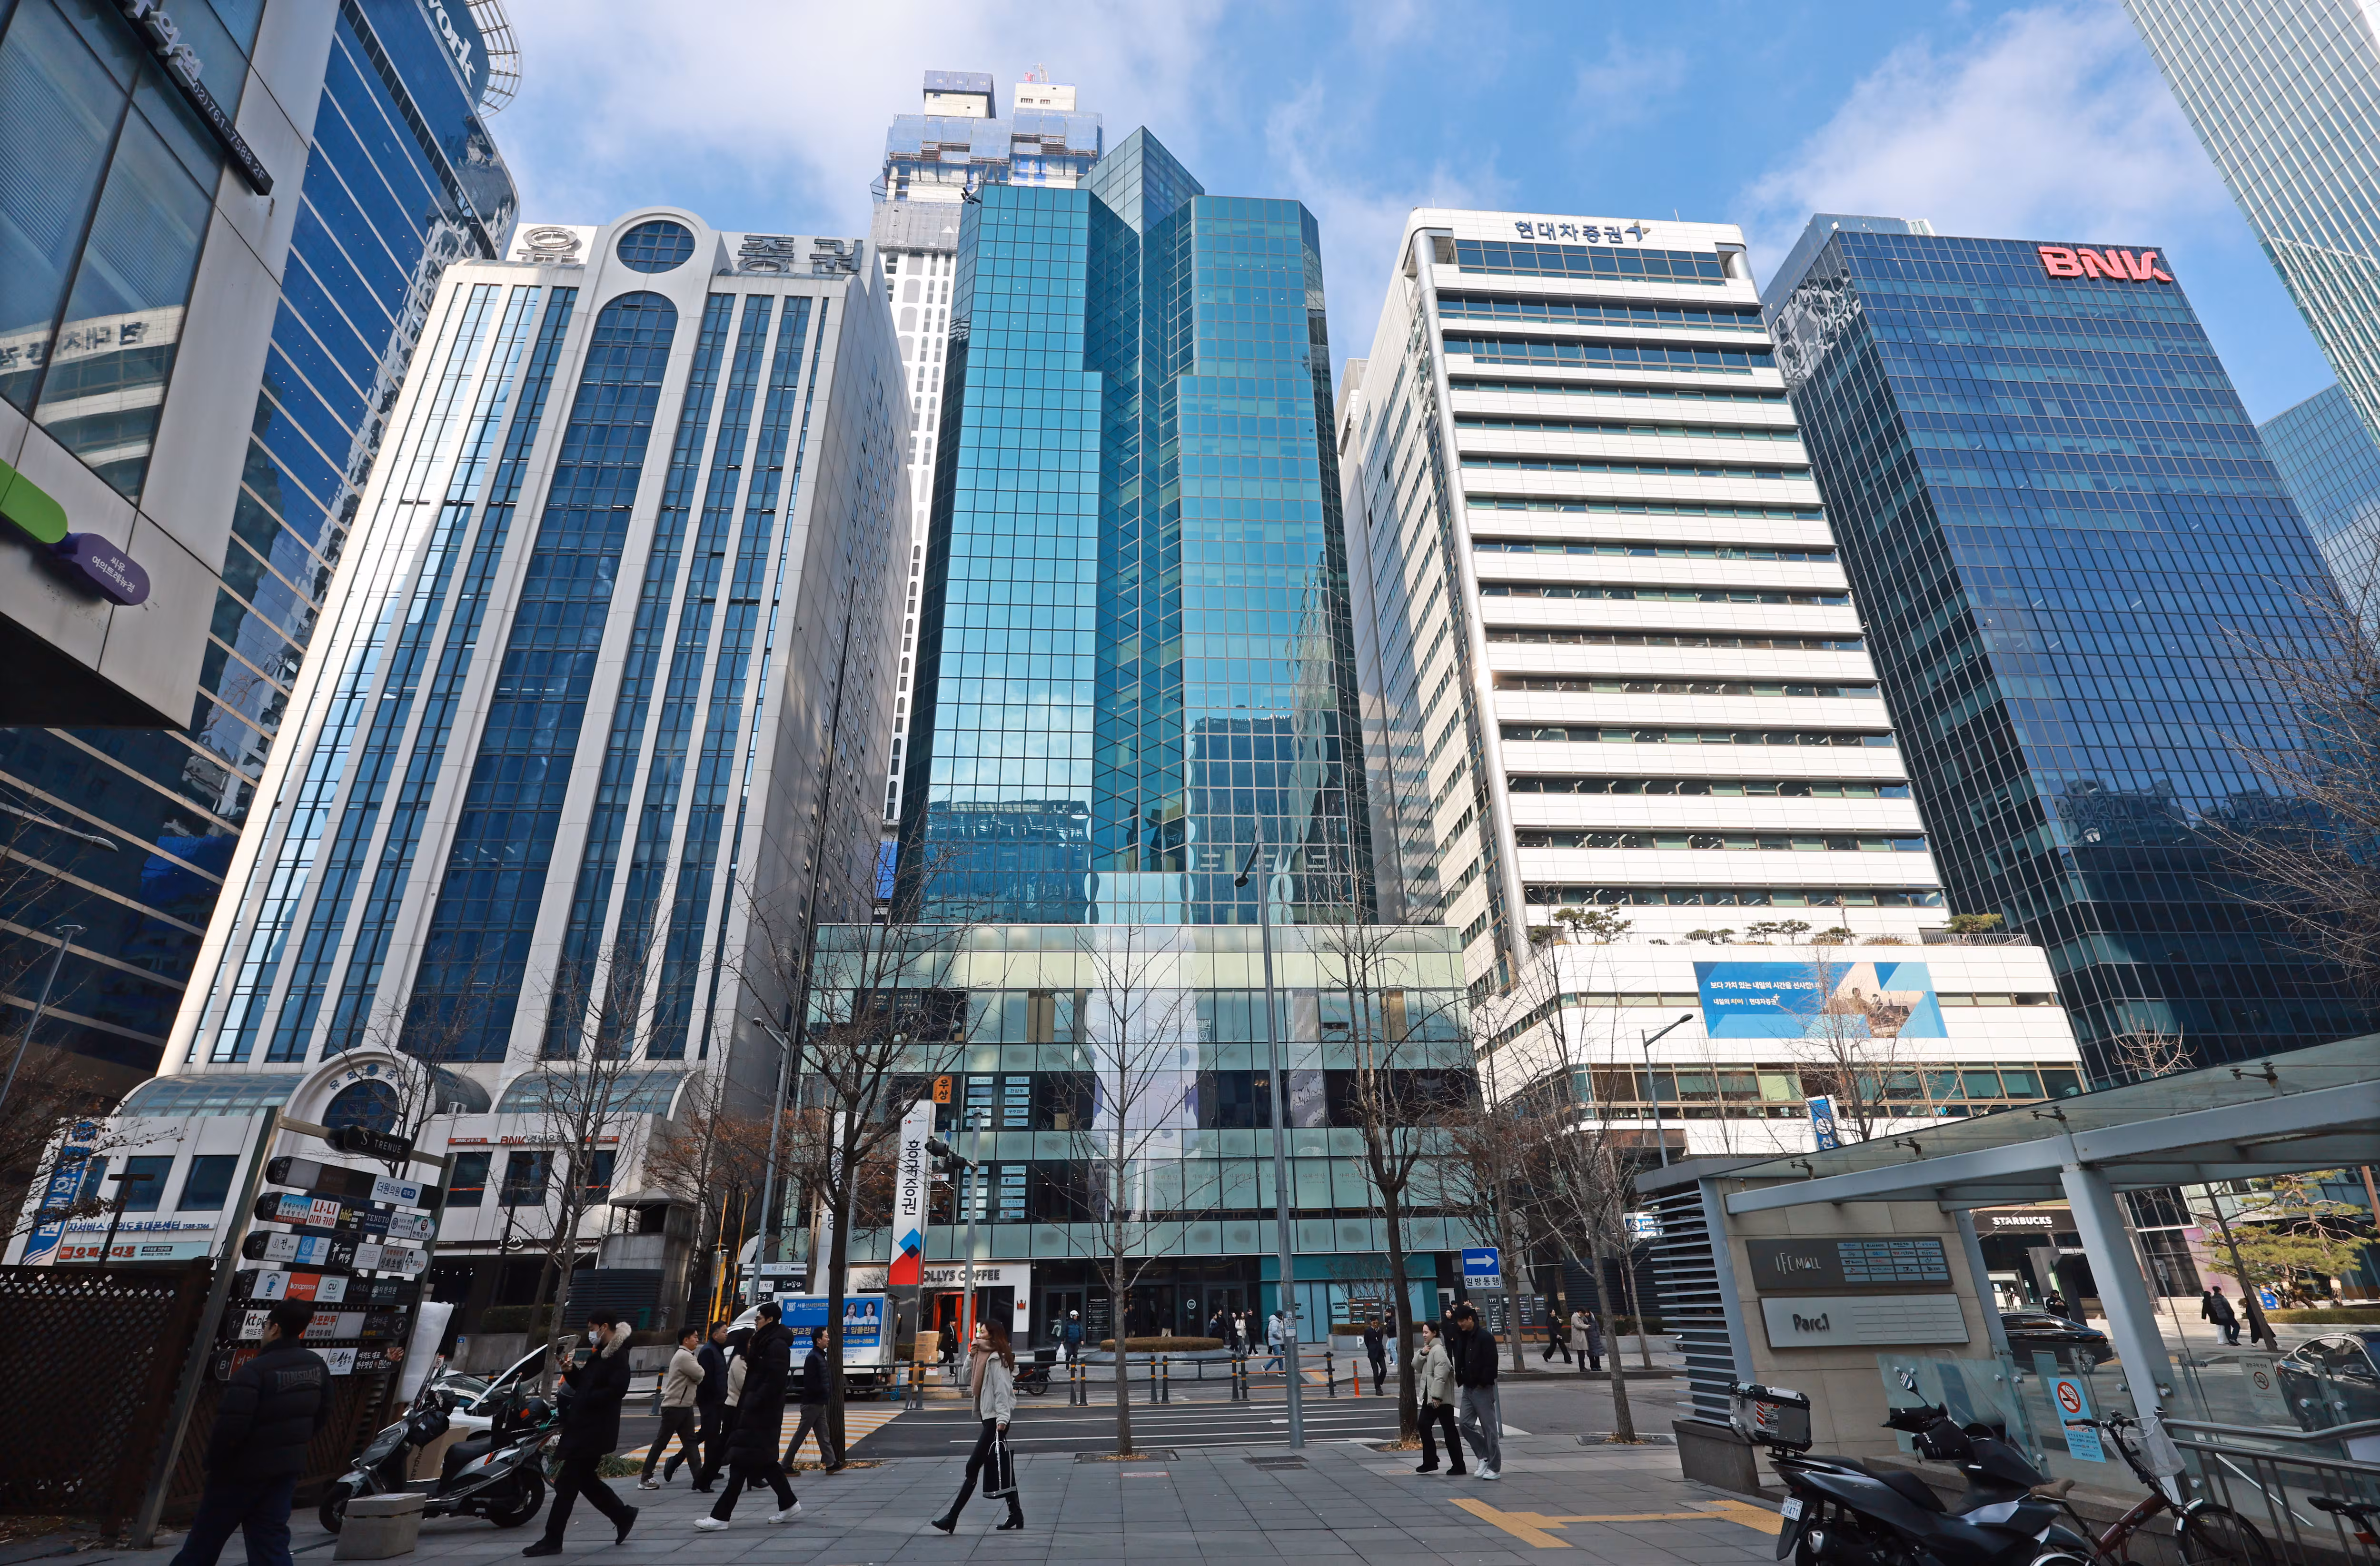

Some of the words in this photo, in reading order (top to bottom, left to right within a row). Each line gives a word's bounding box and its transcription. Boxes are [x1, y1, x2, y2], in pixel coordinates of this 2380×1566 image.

[192, 82, 252, 165] 02)761-7588
[253, 162, 266, 180] 2F
[1515, 220, 1624, 244] 현대차증권
[2038, 246, 2173, 283] BNK
[110, 556, 126, 572] 씨유
[92, 555, 136, 594] 여의트레뉴점
[500, 1136, 526, 1144] BNK
[374, 1139, 402, 1154] TRENUE
[276, 1171, 285, 1179] 3F
[901, 1140, 922, 1215] 흥국증권
[377, 1182, 401, 1197] 더원의원
[267, 1201, 277, 1210] 3F
[339, 1208, 352, 1222] bhc
[366, 1214, 389, 1224] TENUTO
[1992, 1216, 2053, 1226] STARBUCKS
[412, 1230, 431, 1239] 한마음약국
[255, 1240, 266, 1249] 2F
[1775, 1252, 1794, 1275] IFC
[245, 1273, 255, 1283] 2F
[923, 1269, 956, 1282] OLLYS
[290, 1282, 316, 1290] banapresso
[1466, 1277, 1500, 1286] 일방통행
[245, 1313, 257, 1327] kt
[1792, 1312, 1830, 1331] Parc.1
[851, 1326, 876, 1334] 임플란트
[358, 1352, 371, 1360] 여의도
[356, 1360, 374, 1369] 한우맛집
[1785, 1506, 1798, 1517] 1471
